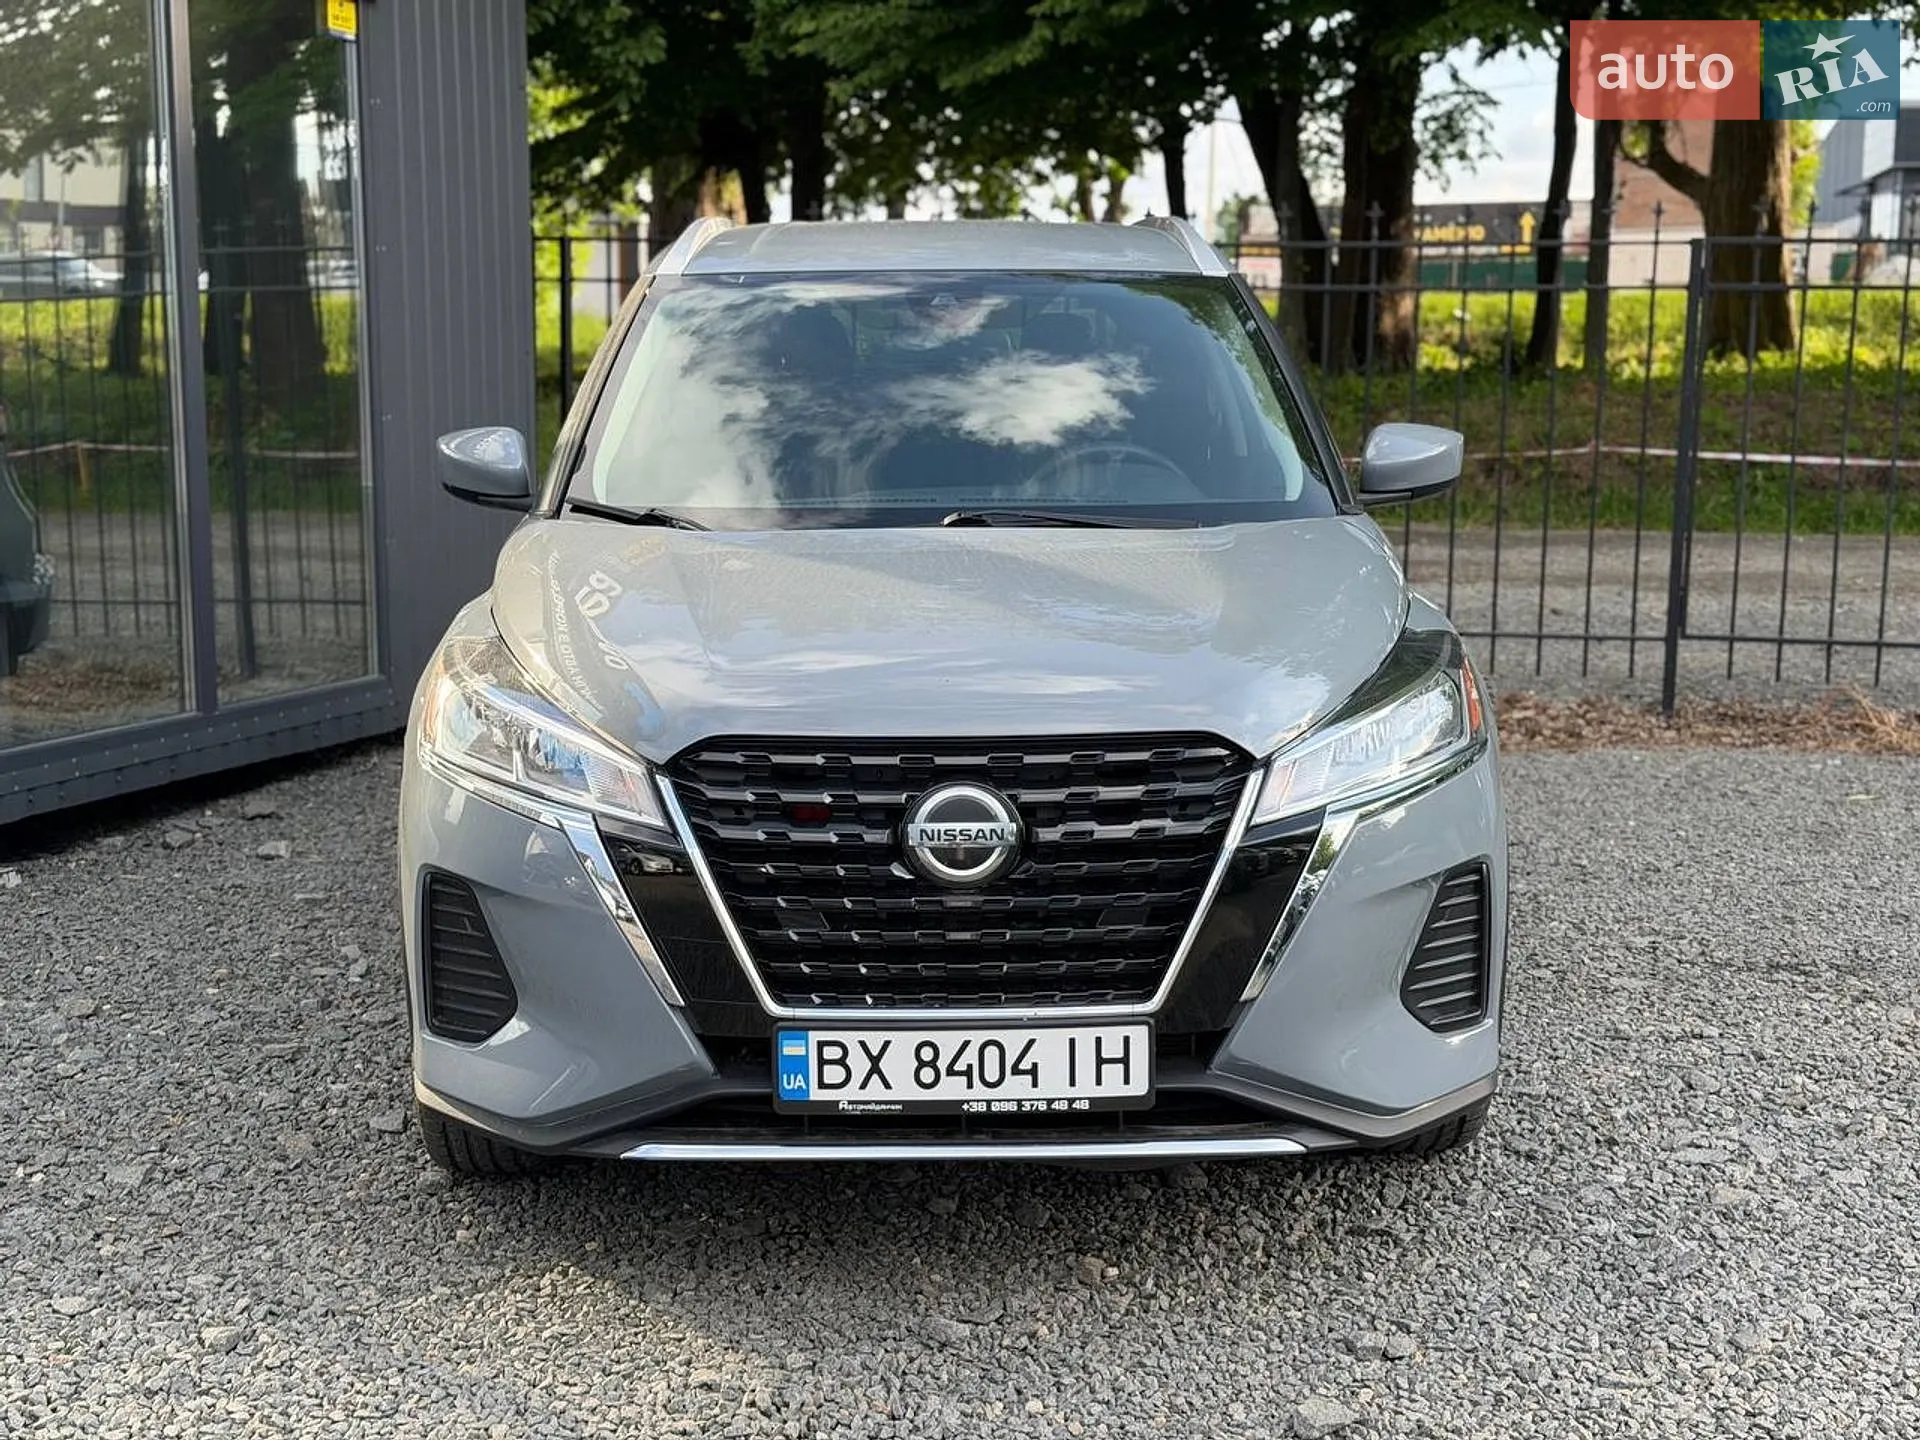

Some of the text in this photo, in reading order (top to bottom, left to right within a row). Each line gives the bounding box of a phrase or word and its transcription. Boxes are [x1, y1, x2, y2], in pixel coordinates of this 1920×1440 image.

[919, 828, 1005, 842] NISSAN
[815, 1034, 1131, 1090] BX 8404 IH
[783, 1074, 806, 1090] UA
[961, 1099, 1090, 1112] +38 096 376 48 48
